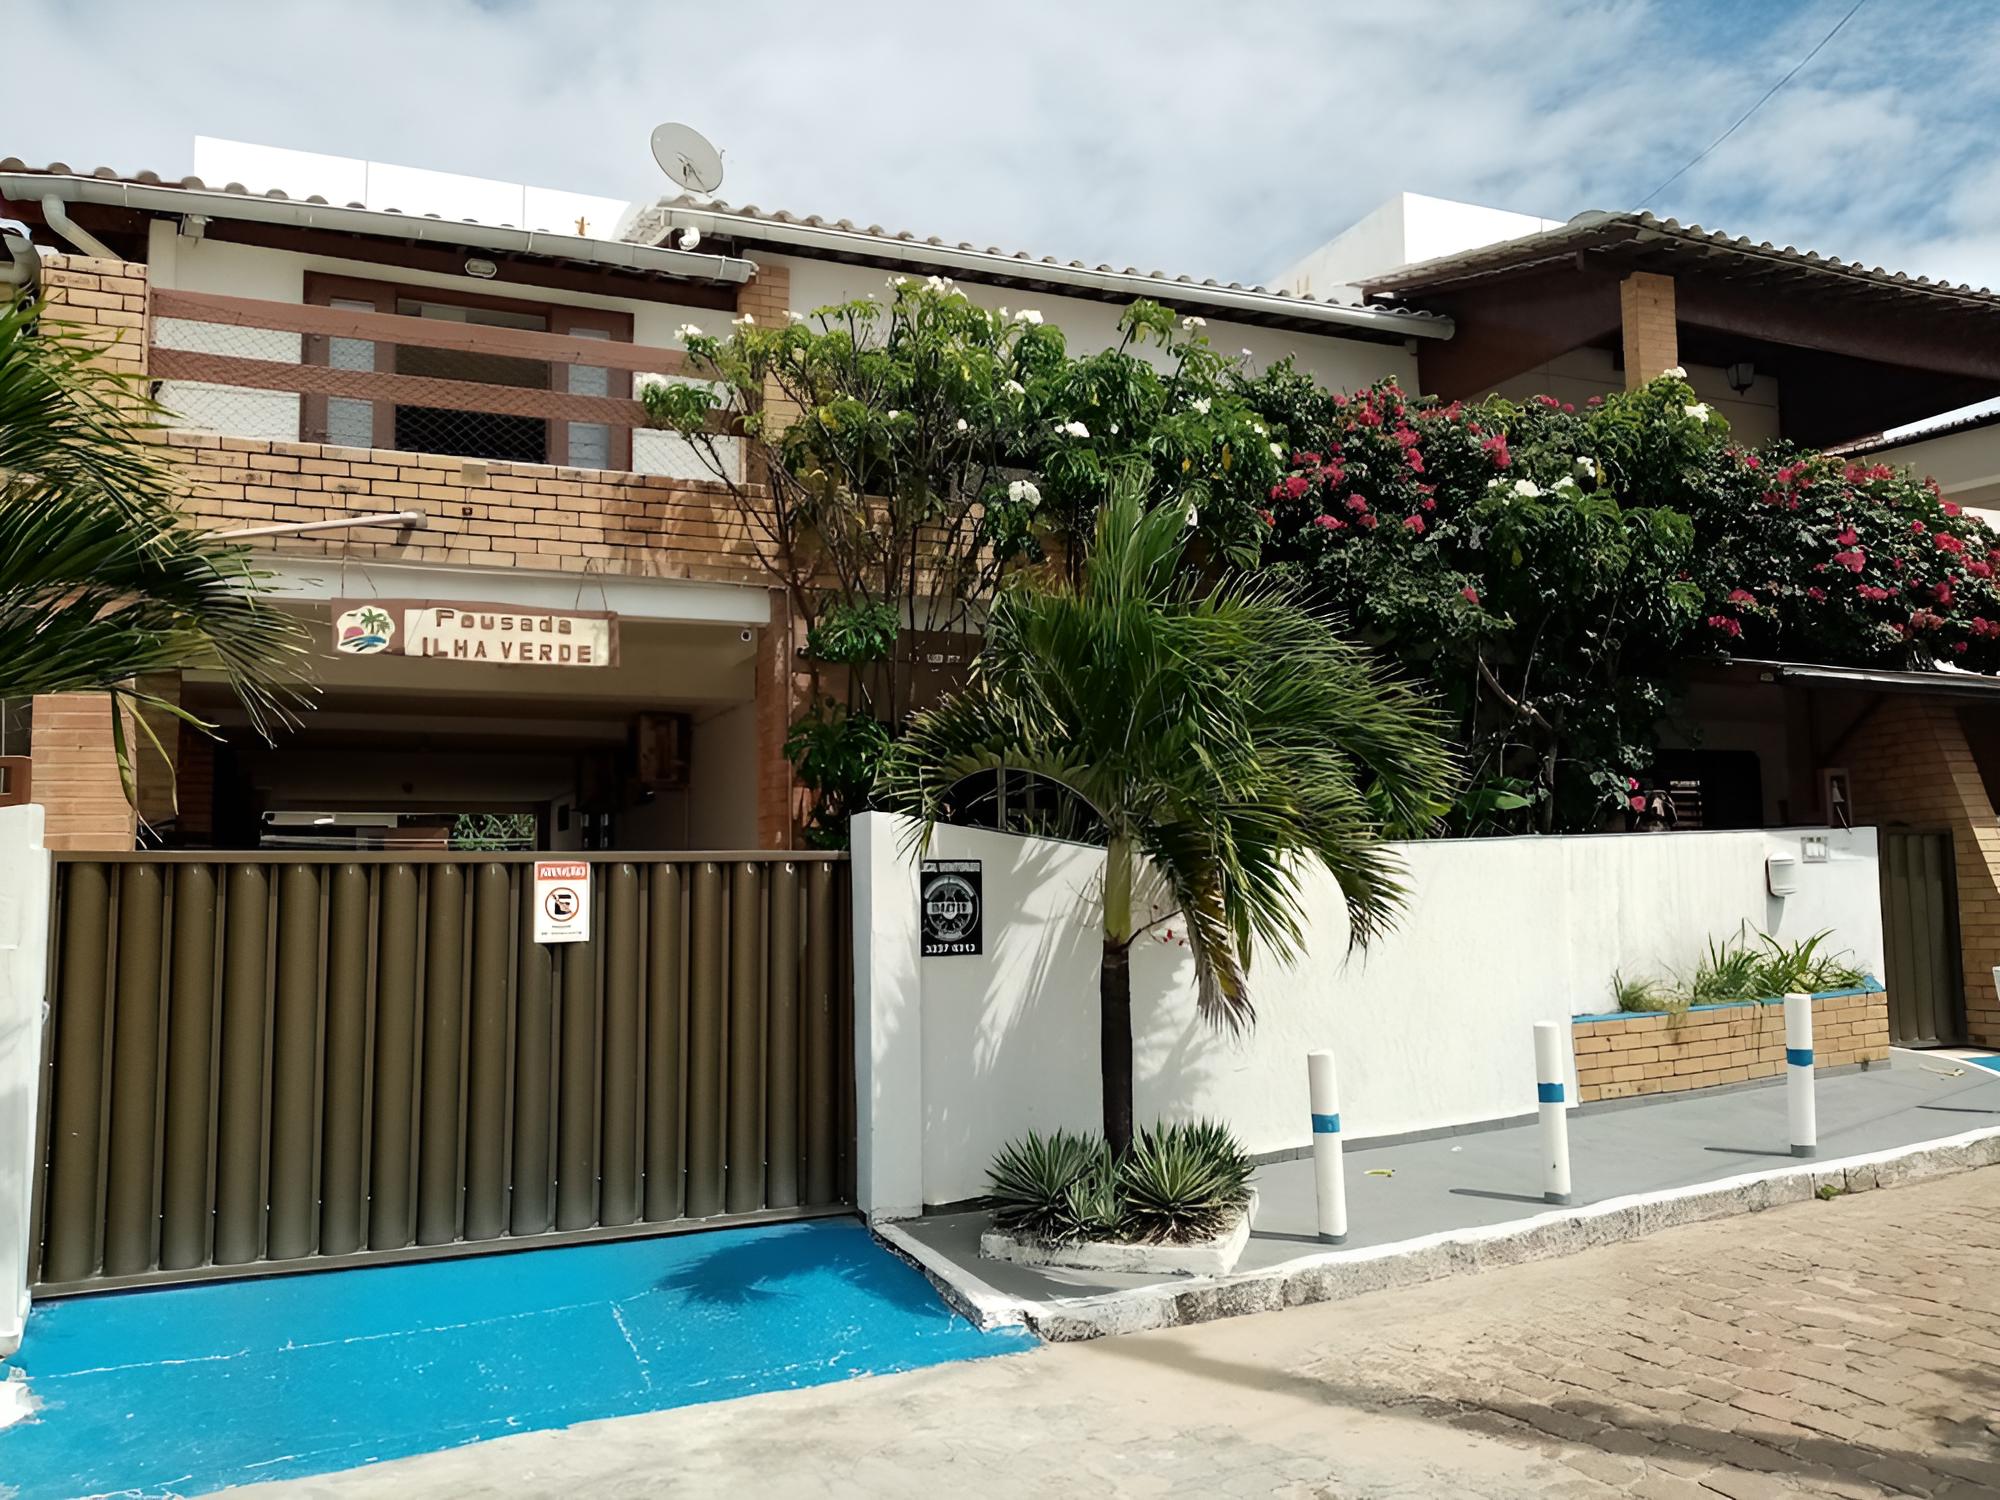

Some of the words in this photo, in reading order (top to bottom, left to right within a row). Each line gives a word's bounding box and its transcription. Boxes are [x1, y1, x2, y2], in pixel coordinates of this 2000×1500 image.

[435, 608, 572, 634] Pousada
[422, 637, 487, 659] ILHA
[500, 641, 591, 663] VERDE
